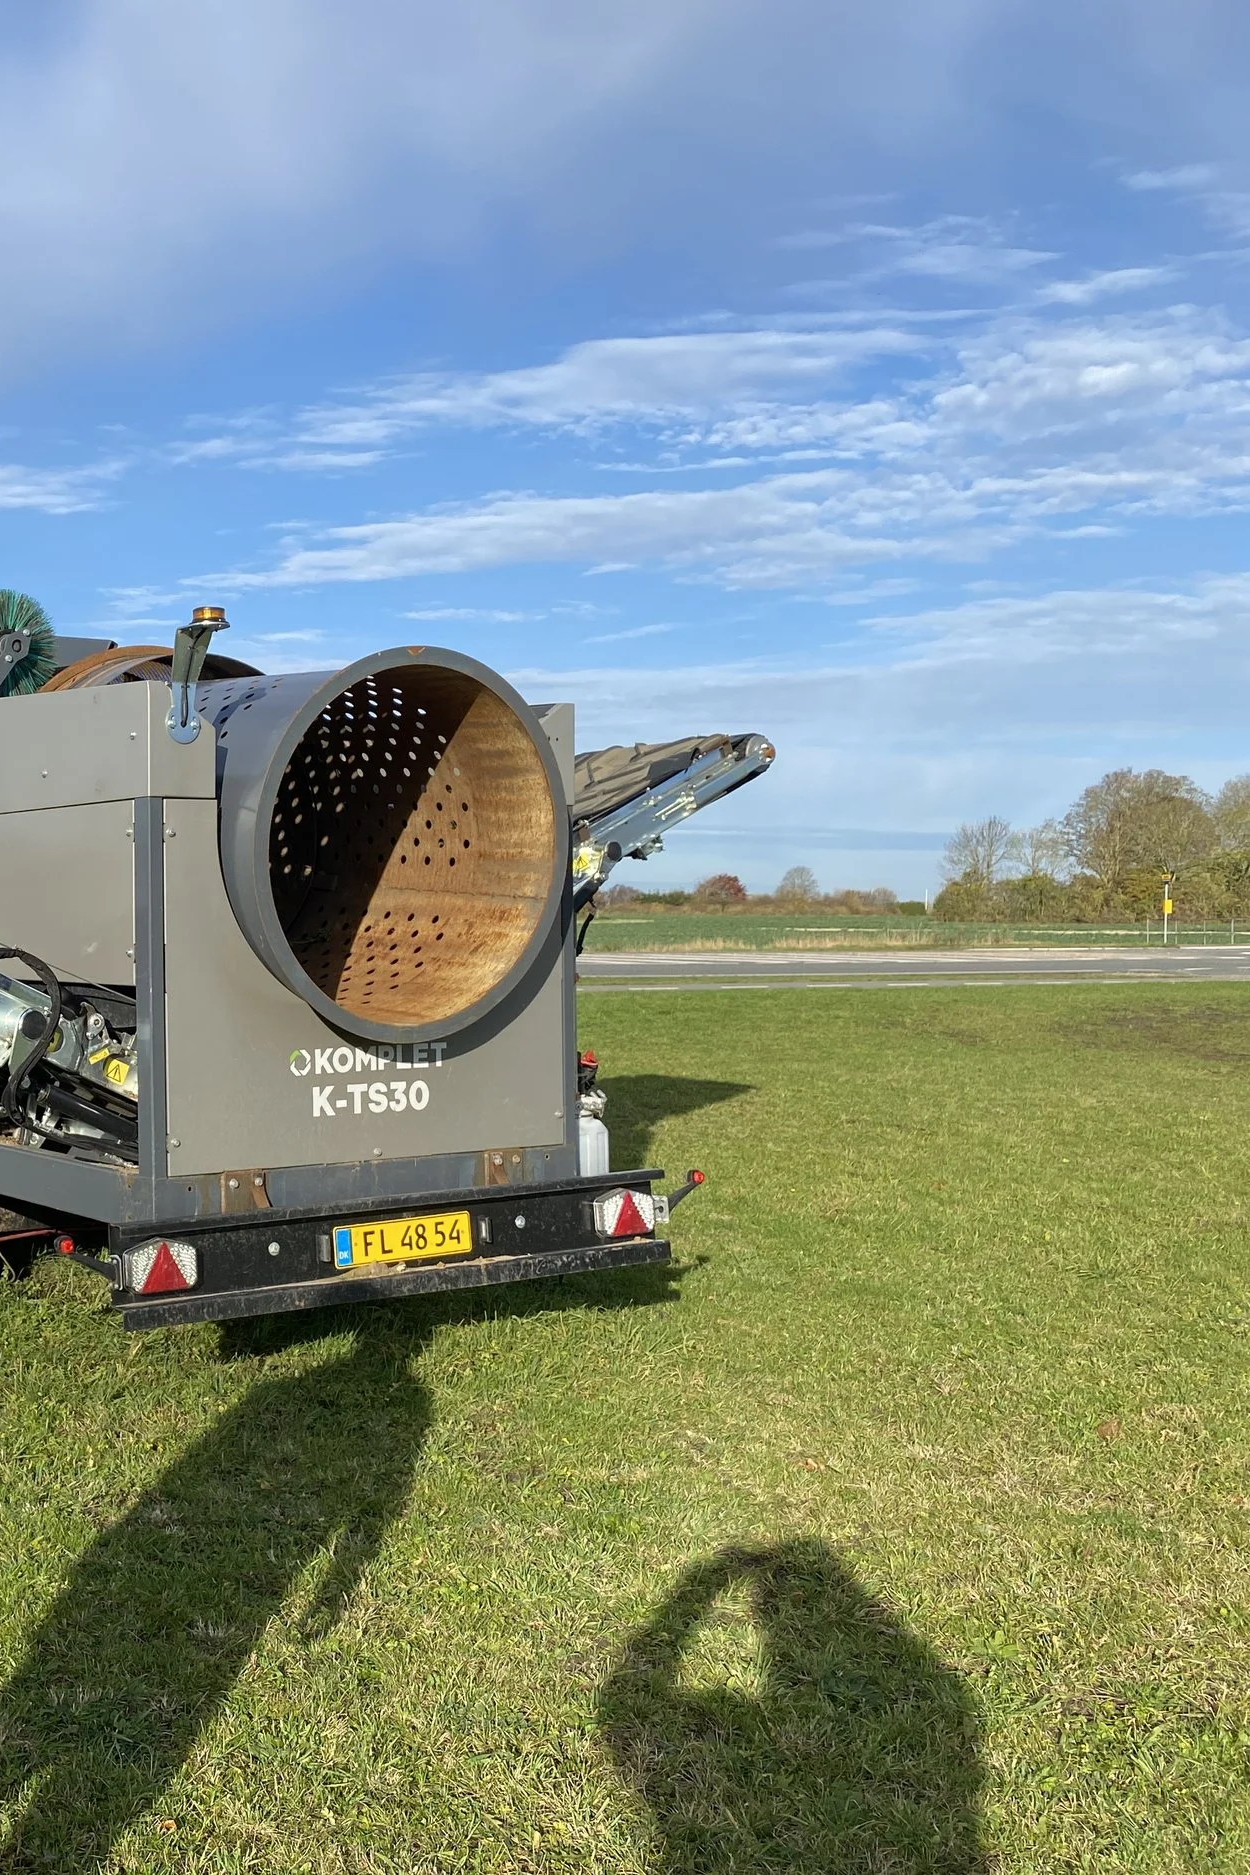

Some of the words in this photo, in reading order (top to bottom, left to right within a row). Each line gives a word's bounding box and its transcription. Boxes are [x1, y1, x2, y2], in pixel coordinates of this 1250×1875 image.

[314, 1042, 448, 1075] KOMPLET
[311, 1080, 431, 1118] K-TS30
[338, 1250, 350, 1260] DK
[362, 1229, 394, 1257] FL
